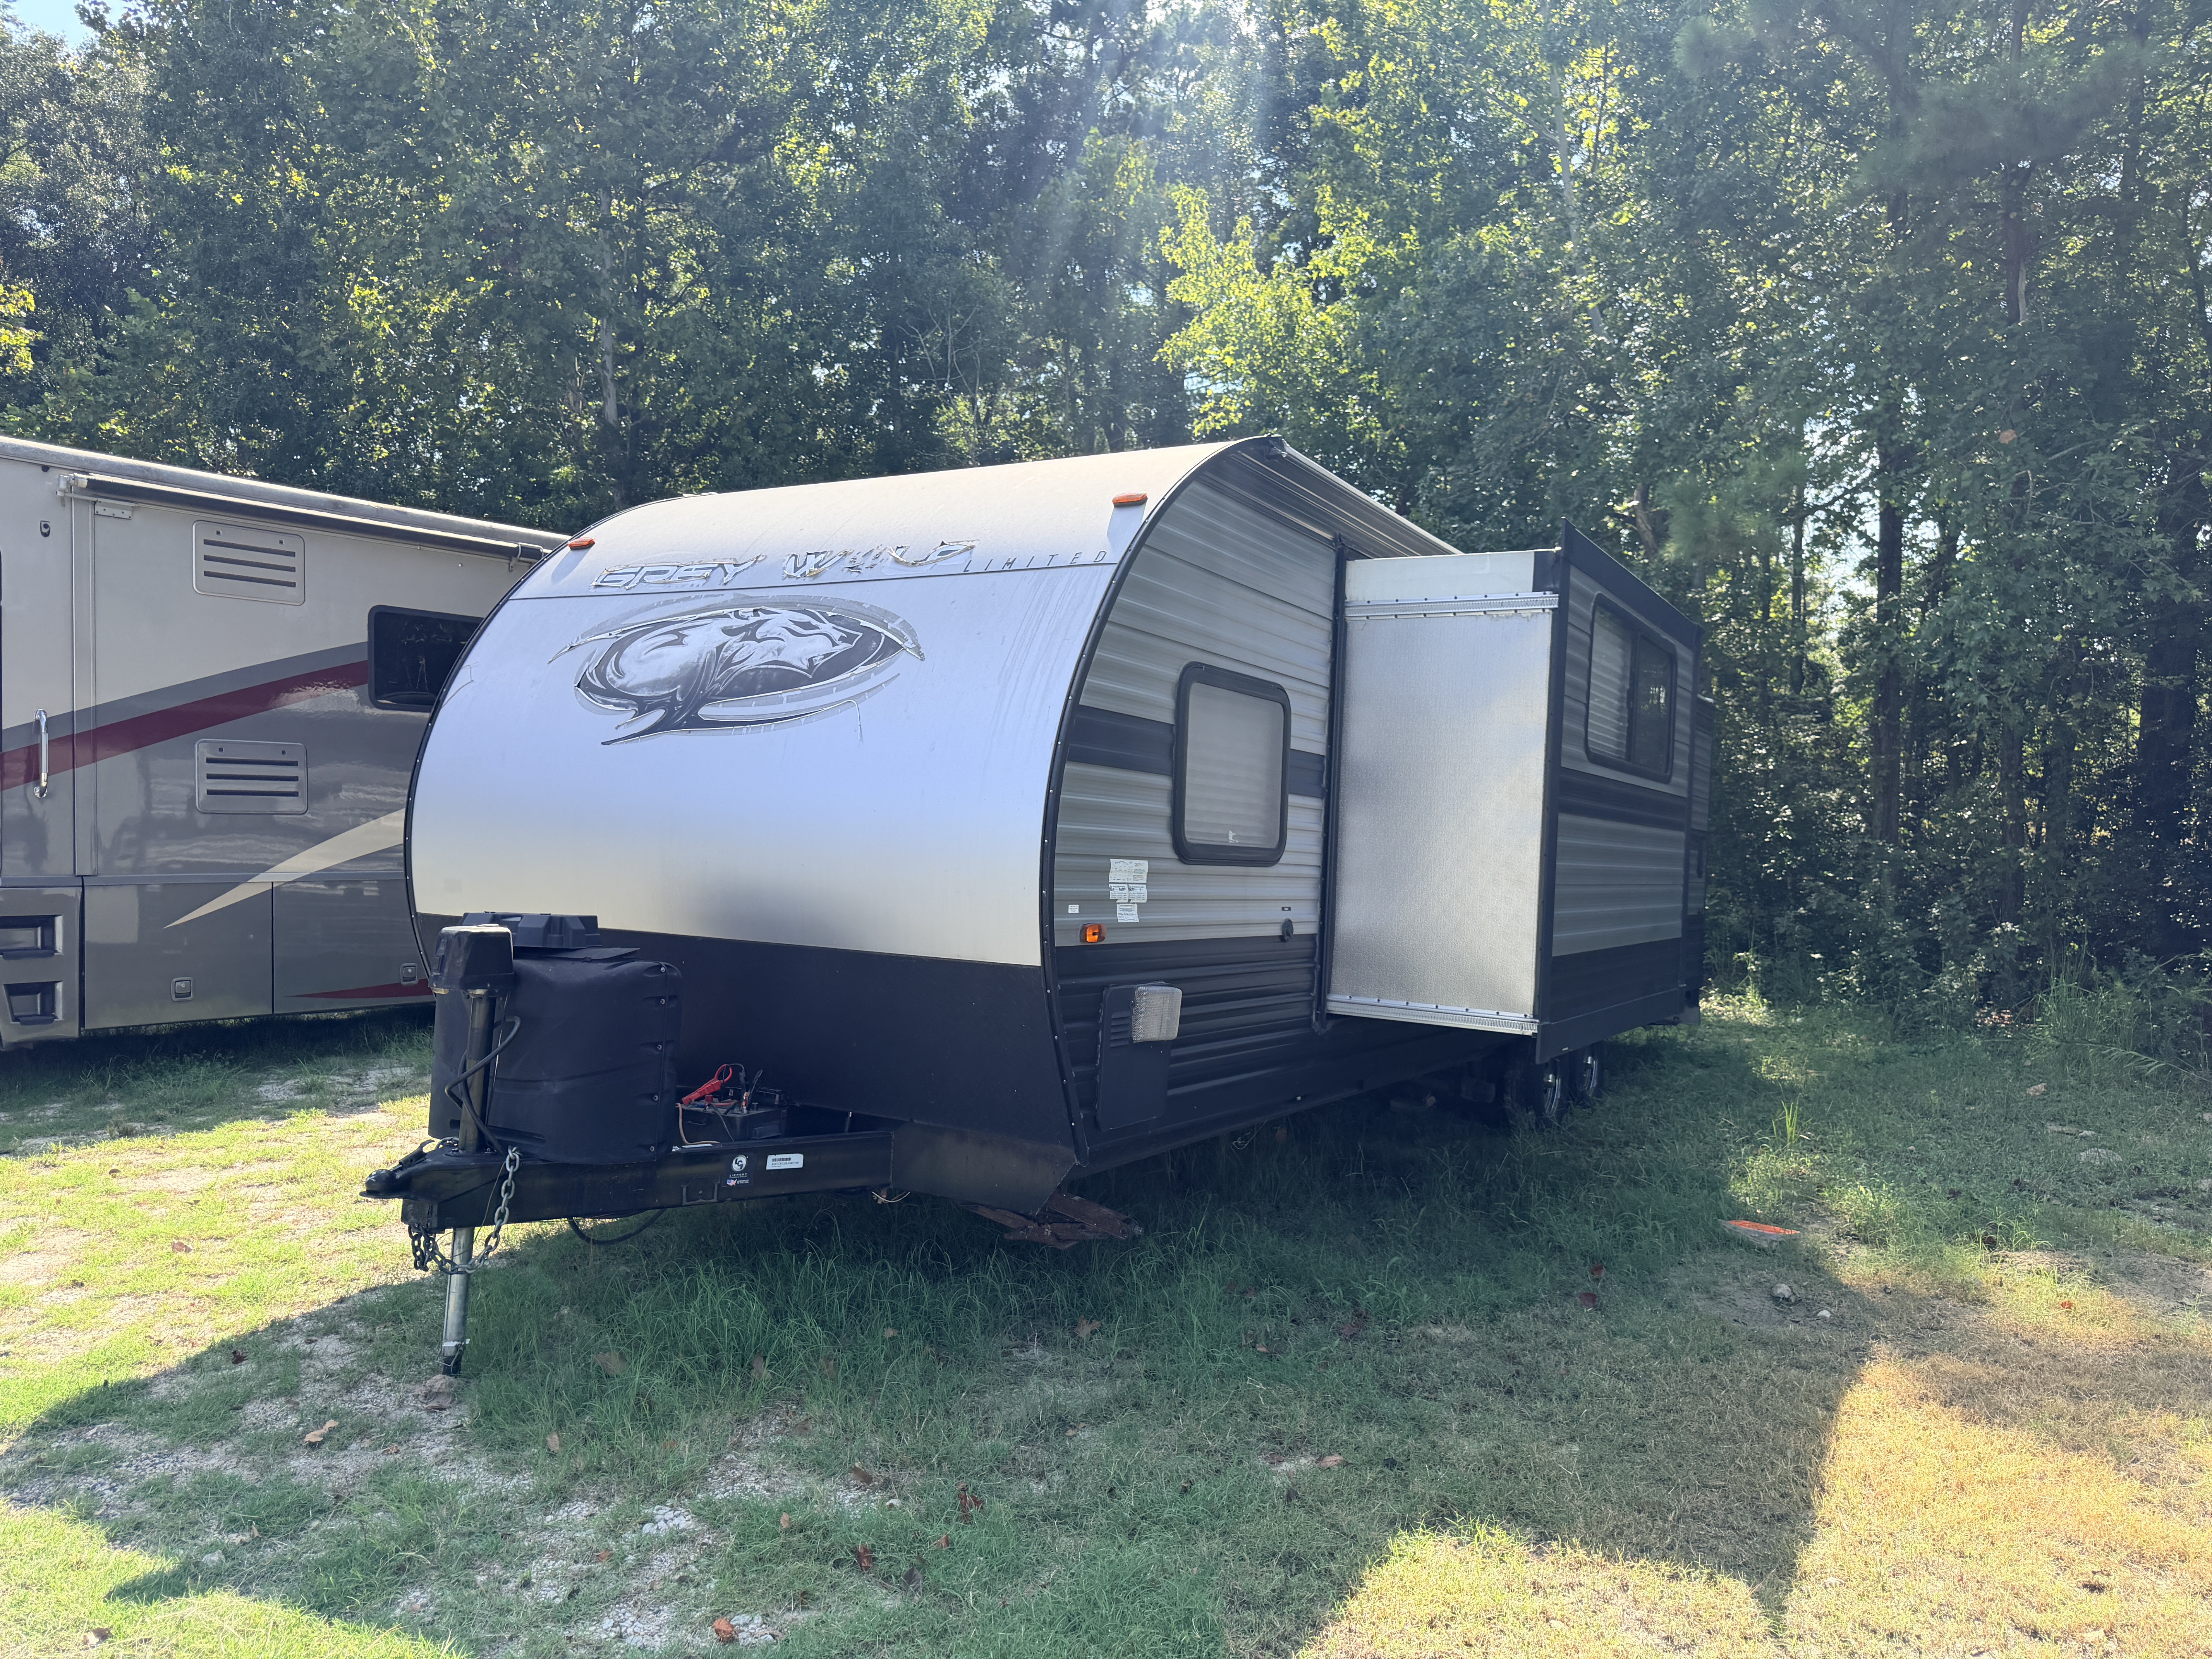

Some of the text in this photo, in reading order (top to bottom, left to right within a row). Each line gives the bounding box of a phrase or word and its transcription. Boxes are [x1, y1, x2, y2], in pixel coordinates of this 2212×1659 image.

[591, 541, 1107, 589] GREY WLF LIMITED
